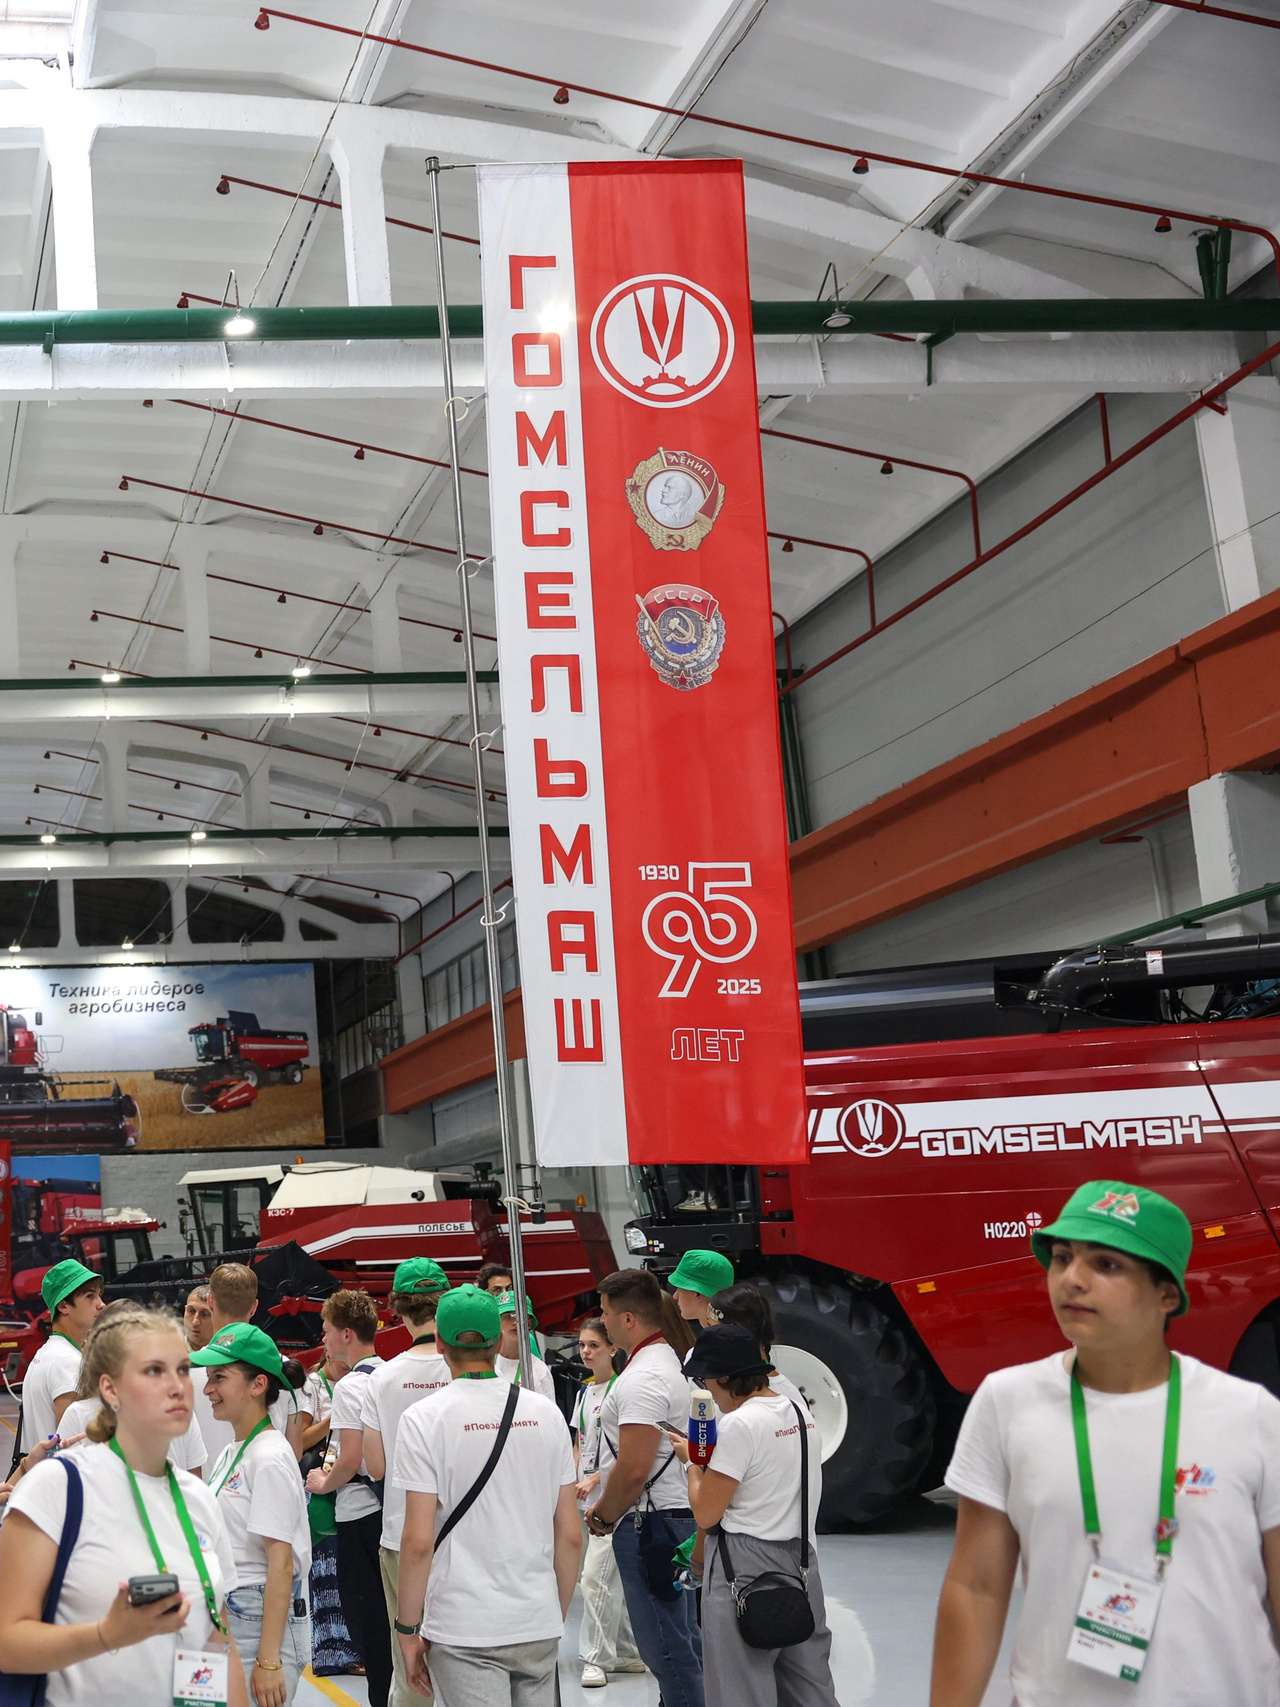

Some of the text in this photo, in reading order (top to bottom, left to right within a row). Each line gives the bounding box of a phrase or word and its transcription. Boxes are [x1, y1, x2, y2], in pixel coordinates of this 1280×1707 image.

[670, 455, 711, 477] ЛЕНИН
[653, 589, 703, 604] СССР
[508, 254, 606, 1064] ГОМСЕЛЬМАШ
[638, 864, 680, 881] 1930
[641, 861, 758, 998] 95
[49, 980, 205, 999] Техника лидеров
[716, 978, 762, 995] 2025
[69, 998, 187, 1017] агробизнеса
[670, 1027, 745, 1063] ЛЕТ
[920, 1116, 1204, 1158] GOMSELMASH
[418, 1223, 466, 1233] ПОЛЕСЬЕ
[402, 1380, 451, 1390] #ПоездПам
[463, 1420, 539, 1433] #Поездамяти
